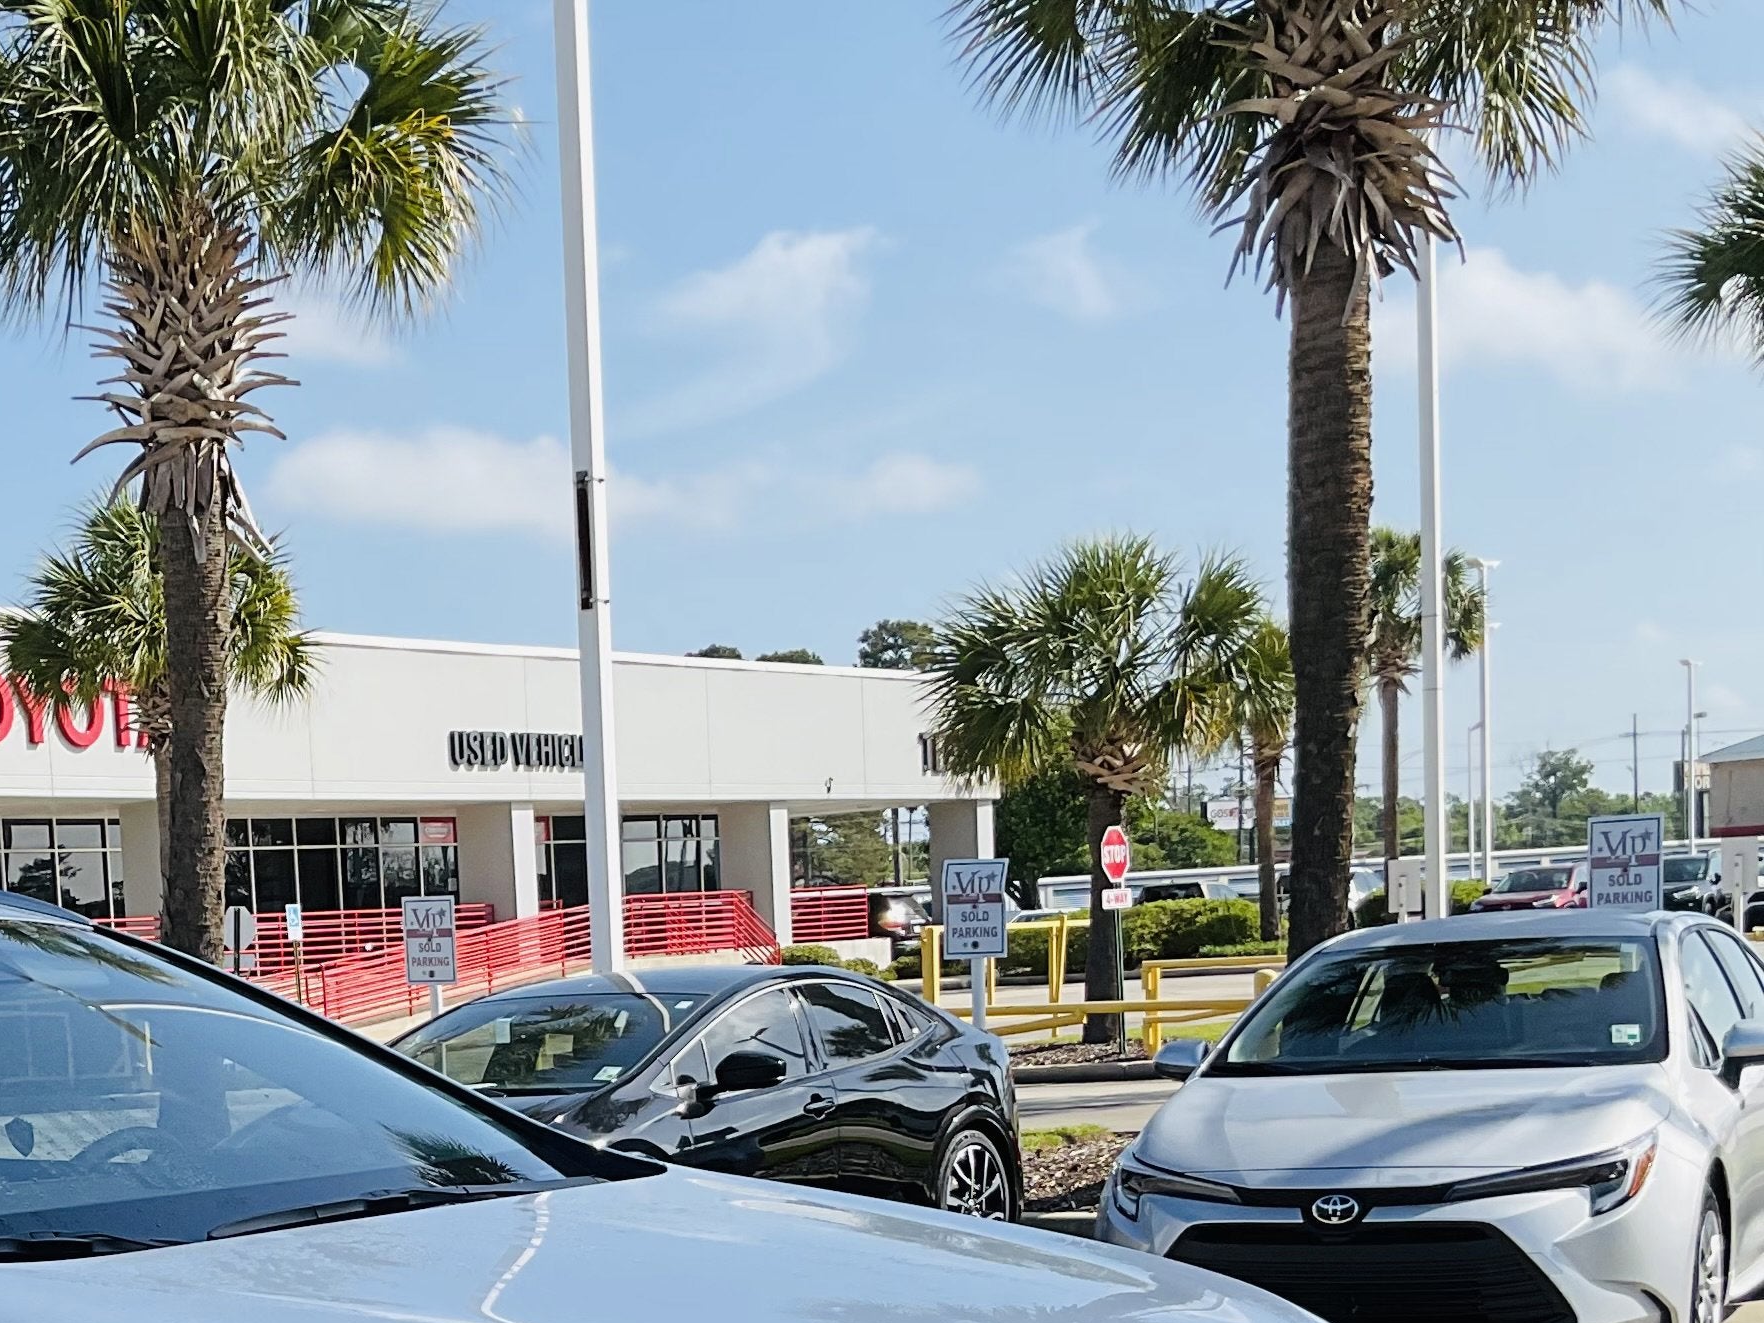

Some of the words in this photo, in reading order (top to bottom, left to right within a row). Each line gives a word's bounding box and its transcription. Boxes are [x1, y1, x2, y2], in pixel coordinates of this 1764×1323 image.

[448, 730, 508, 767] USED
[509, 732, 584, 769] VEHICL
[1104, 845, 1126, 864] STOP
[1608, 873, 1642, 887] SOLD
[1597, 891, 1653, 905] PARKING
[961, 911, 989, 922] SOLD
[952, 927, 998, 938] PARKING
[418, 943, 442, 953] SOLD
[411, 957, 450, 967] PARKING
